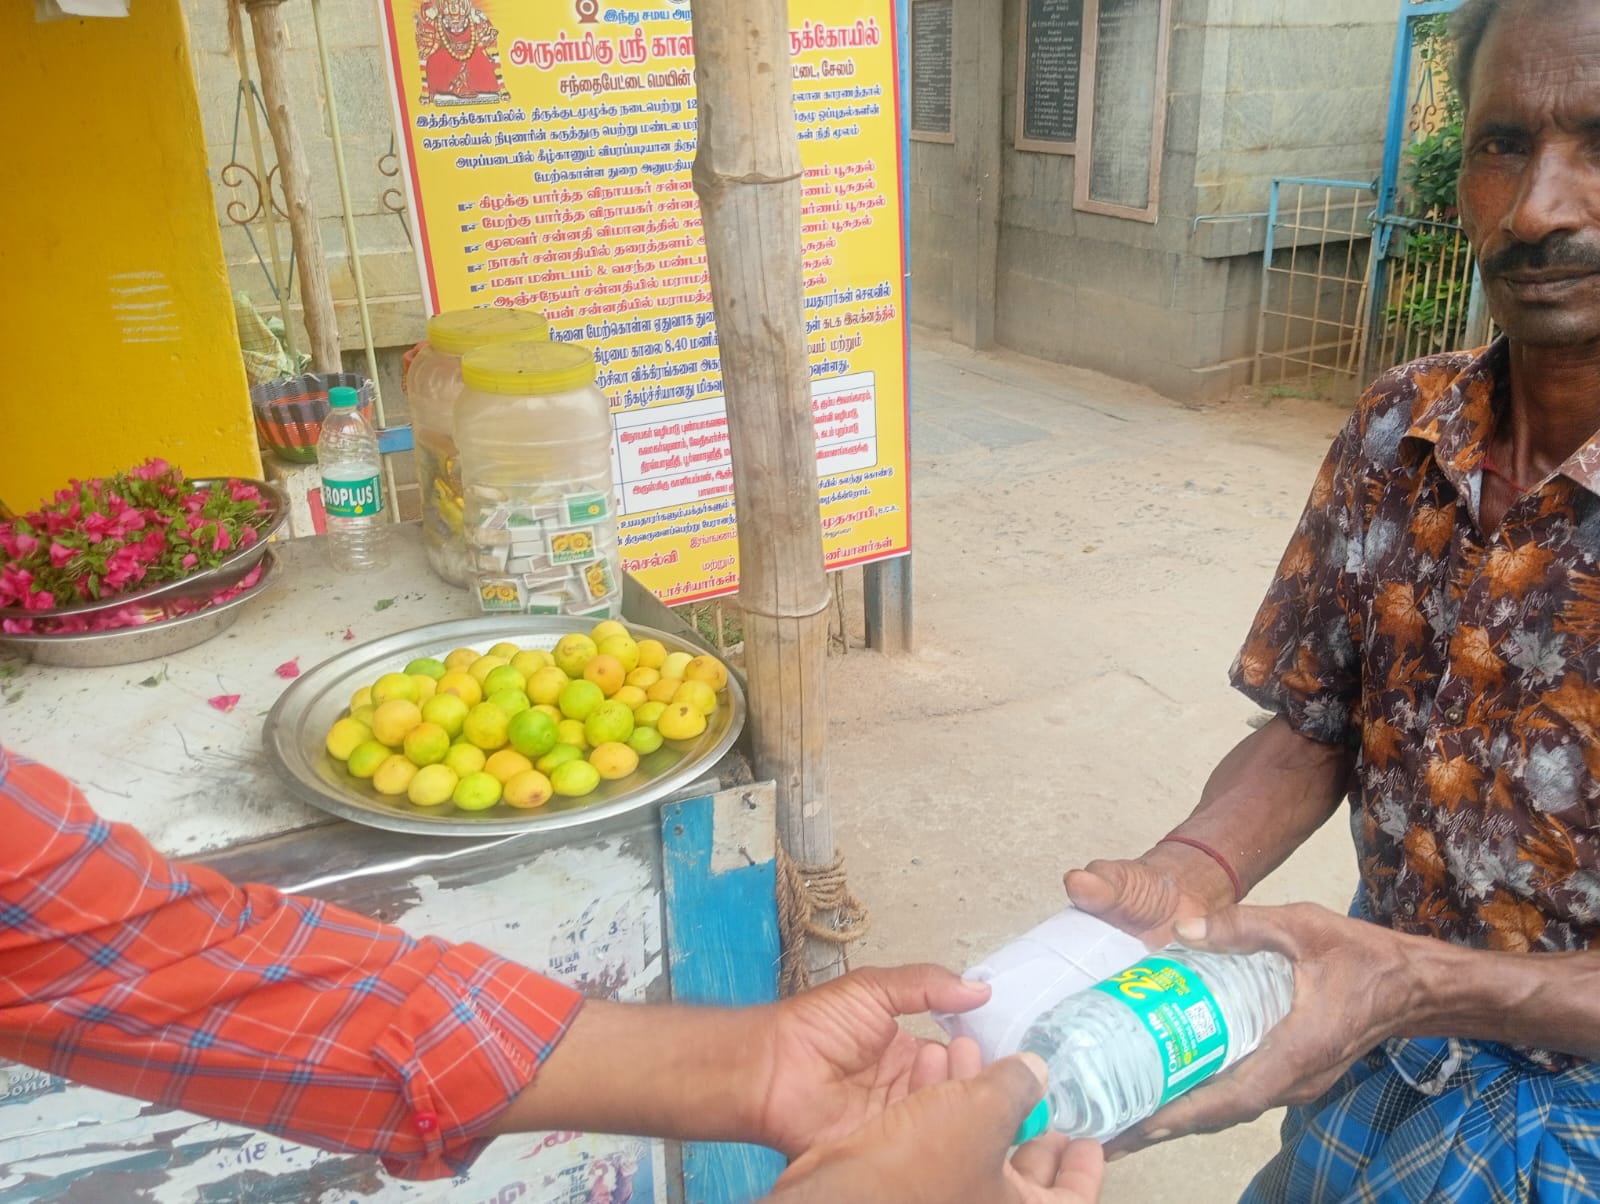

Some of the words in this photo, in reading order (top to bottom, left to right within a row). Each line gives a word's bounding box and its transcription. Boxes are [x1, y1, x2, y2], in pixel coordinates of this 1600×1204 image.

[604, 9, 640, 25] இந்து
[642, 10, 669, 21] சமய
[510, 31, 614, 70] அருள்மிகு
[619, 28, 647, 64] ஸ்ரீ
[648, 69, 691, 88] மெயின்
[822, 59, 854, 77] சேலம்
[416, 109, 525, 129] இத்திருக்கோயிலில்
[620, 99, 682, 116] நடைபெற்று
[423, 132, 492, 150] தொல்லியல்
[602, 122, 638, 137] பெற்று
[640, 120, 680, 132] மண்டல
[456, 150, 534, 168] அடிப்படையில்
[479, 194, 529, 211] கிழக்கு
[532, 188, 583, 204] பார்த்த
[587, 181, 652, 200] விநாயகர்
[834, 160, 875, 178] பூசுதல்
[534, 166, 604, 184] மேற்கொள்ள
[608, 166, 638, 178] துறை
[482, 213, 532, 230] மேற்கு
[535, 208, 585, 224] பார்த்த
[589, 200, 653, 220] விநாயகர்
[834, 178, 876, 196] பூசுதல்
[485, 232, 538, 251] மூலவர்
[542, 226, 592, 242] சன்னதி
[597, 218, 680, 237] விமானத்தில்
[845, 195, 886, 214] பூசுதல்
[488, 252, 529, 272] நாகர்
[532, 244, 610, 262] சன்னதியில்
[614, 235, 694, 257] தரைத்தளம்
[831, 214, 872, 232] பூசுதல்
[491, 276, 524, 288] மகா
[528, 266, 593, 284] மண்டபம்
[597, 265, 608, 276] &
[611, 260, 656, 274] வசந்த
[494, 286, 582, 308] ஆஞ்சநேயர்
[584, 277, 658, 296] சன்னதியில்
[578, 296, 654, 316] சன்னதியில்
[586, 317, 651, 340] மேற்கொள்ள
[830, 332, 862, 352] மற்றும்
[632, 342, 662, 358] காலை
[664, 338, 688, 352] 8.40
